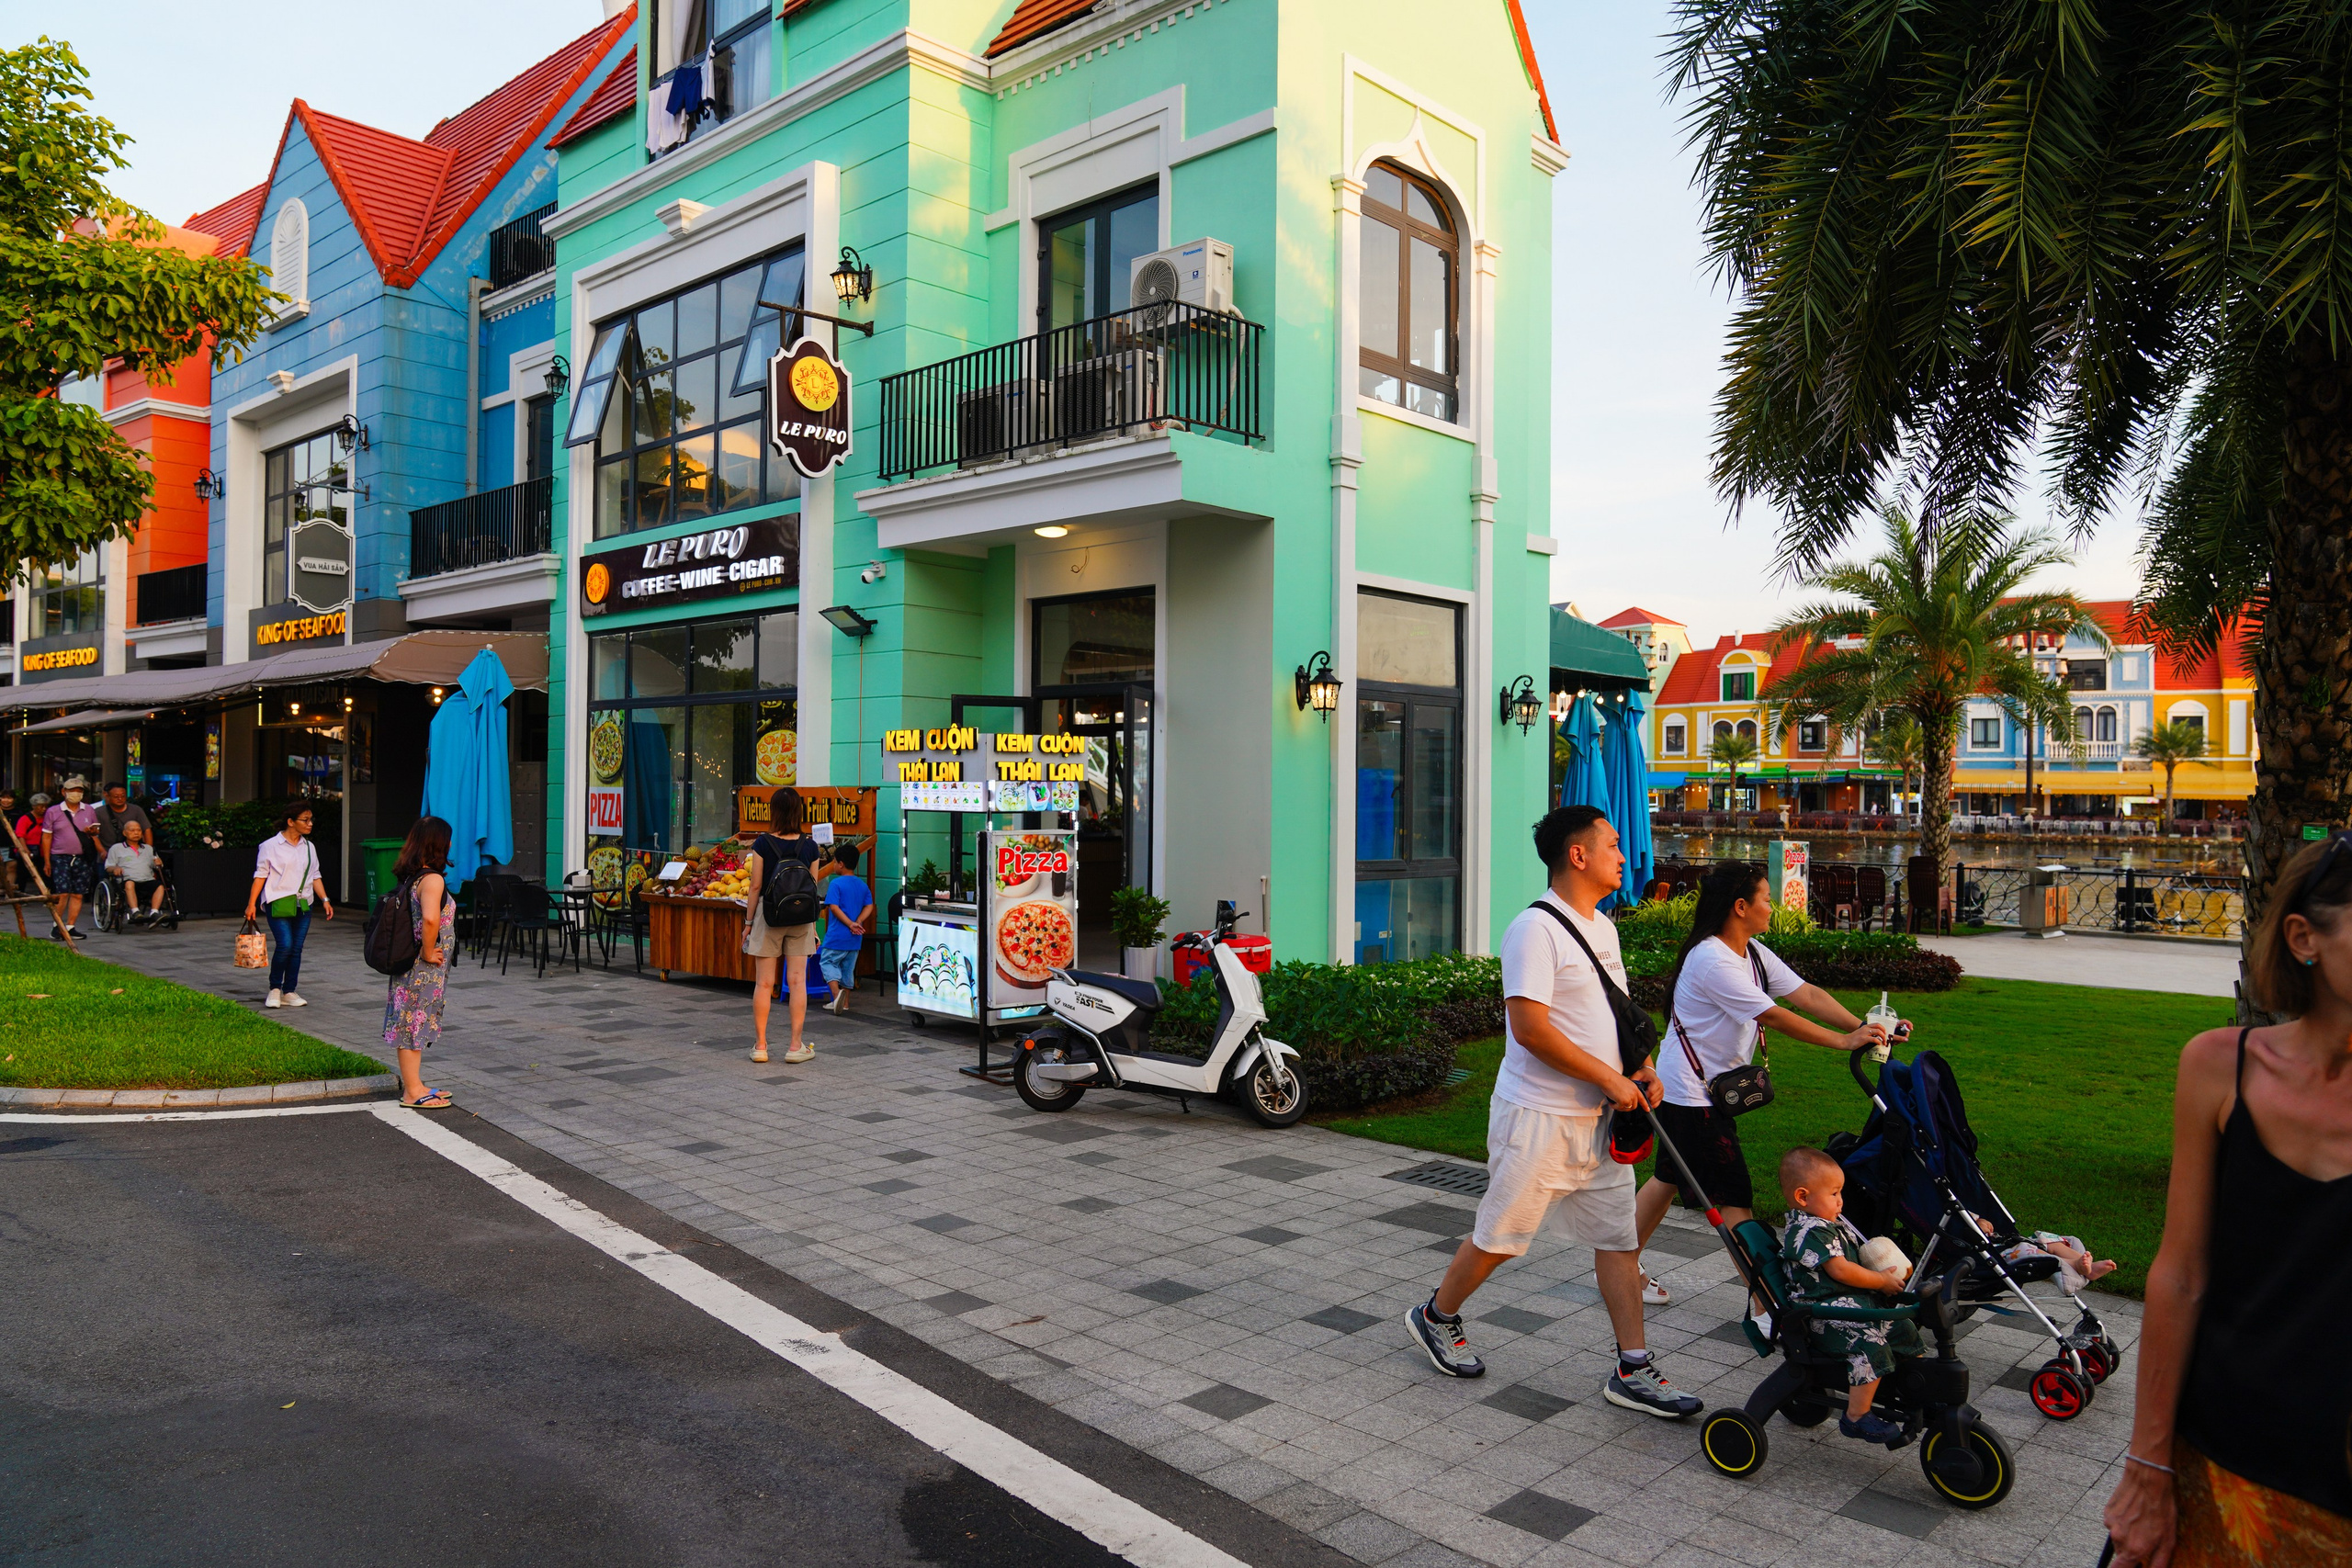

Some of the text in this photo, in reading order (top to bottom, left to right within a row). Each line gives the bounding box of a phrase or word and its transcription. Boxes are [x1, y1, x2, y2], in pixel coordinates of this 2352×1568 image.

[1182, 247, 1204, 256] Panasonic
[780, 421, 847, 445] LE PURO
[642, 526, 749, 569] LE PURO
[257, 622, 282, 645] KING
[283, 619, 299, 642] OF
[23, 647, 98, 671] KING OF SEAFOOD
[886, 723, 975, 755] KEM CUỘN
[996, 731, 1085, 758] KEM CUỘN
[898, 758, 960, 782] THÁI LAN
[998, 758, 1084, 781] THÁI LAN
[590, 793, 623, 828] PIZZA
[807, 796, 830, 823] Fruit
[833, 798, 856, 824] Juice
[998, 845, 1069, 874] Pizza
[1784, 849, 1806, 863] Pizza
[1062, 1002, 1076, 1011] YADEA
